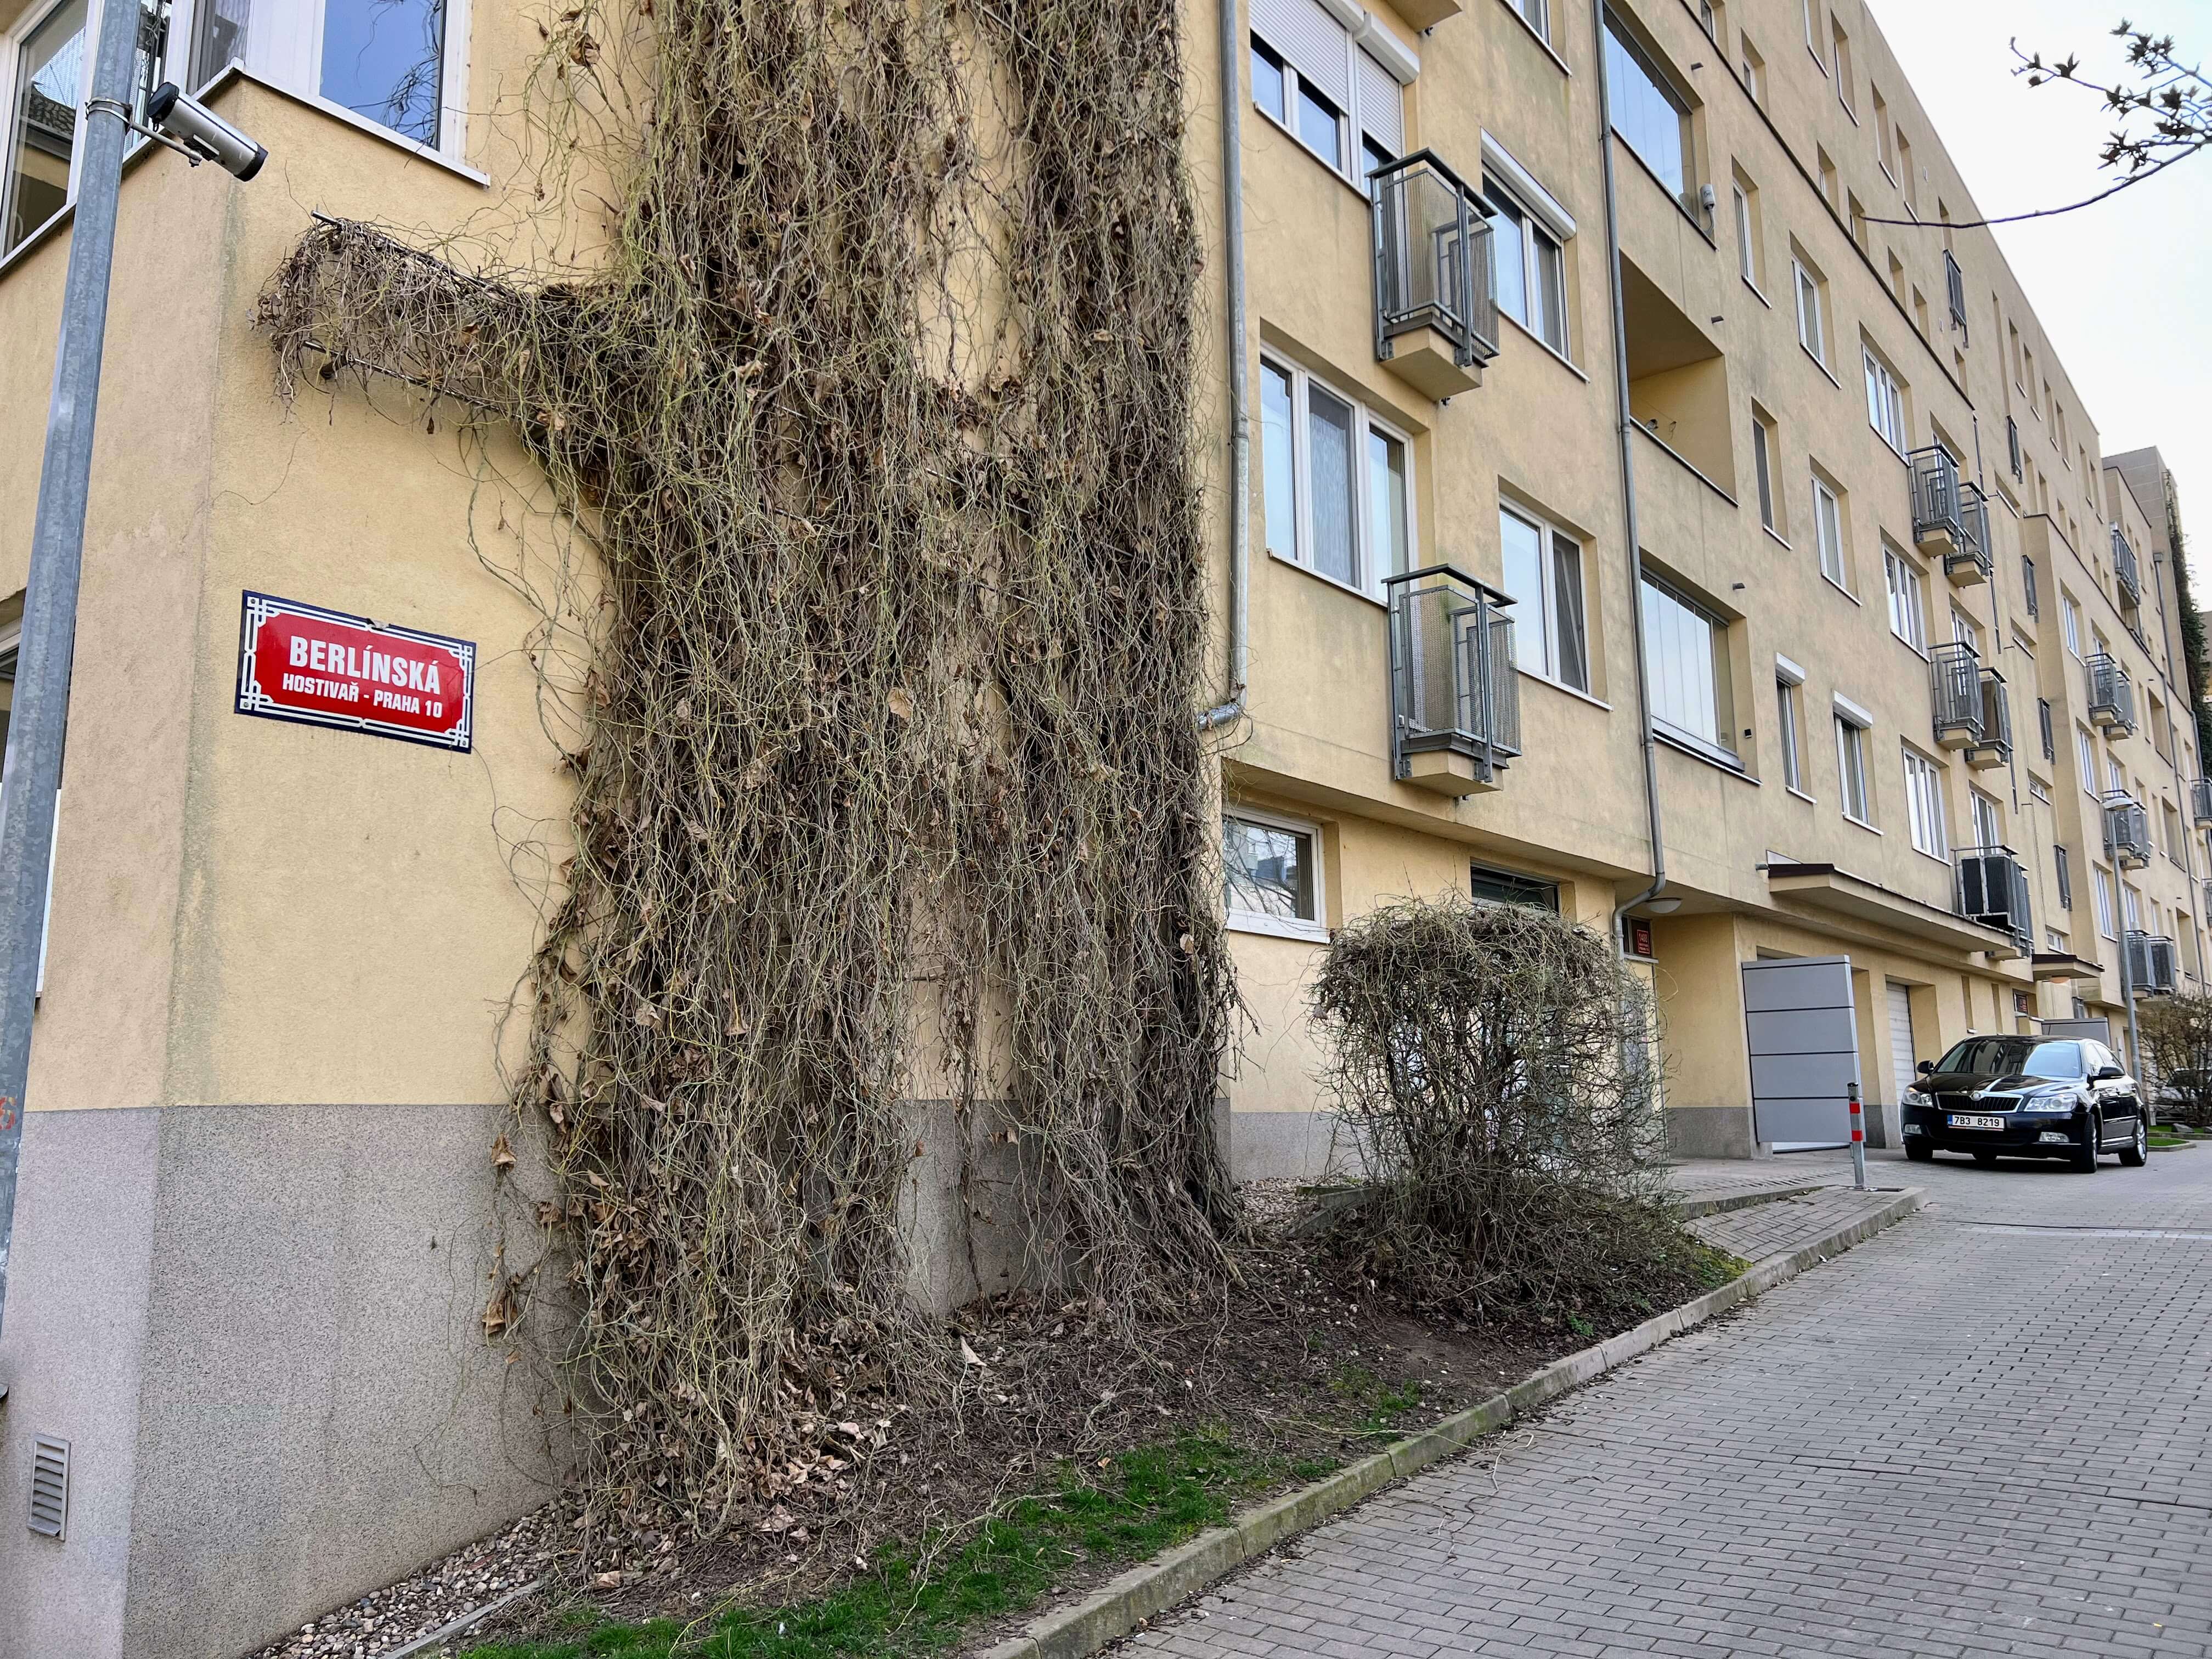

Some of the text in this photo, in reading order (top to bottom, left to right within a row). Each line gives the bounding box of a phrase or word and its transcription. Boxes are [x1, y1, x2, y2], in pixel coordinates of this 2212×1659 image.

[289, 635, 441, 695] BERLÍNSKÁ
[282, 673, 359, 703] HOSTIVAŘ
[373, 689, 420, 715] PRAHA
[425, 699, 443, 719] 10
[1954, 1116, 2000, 1126] 7B3 8219
